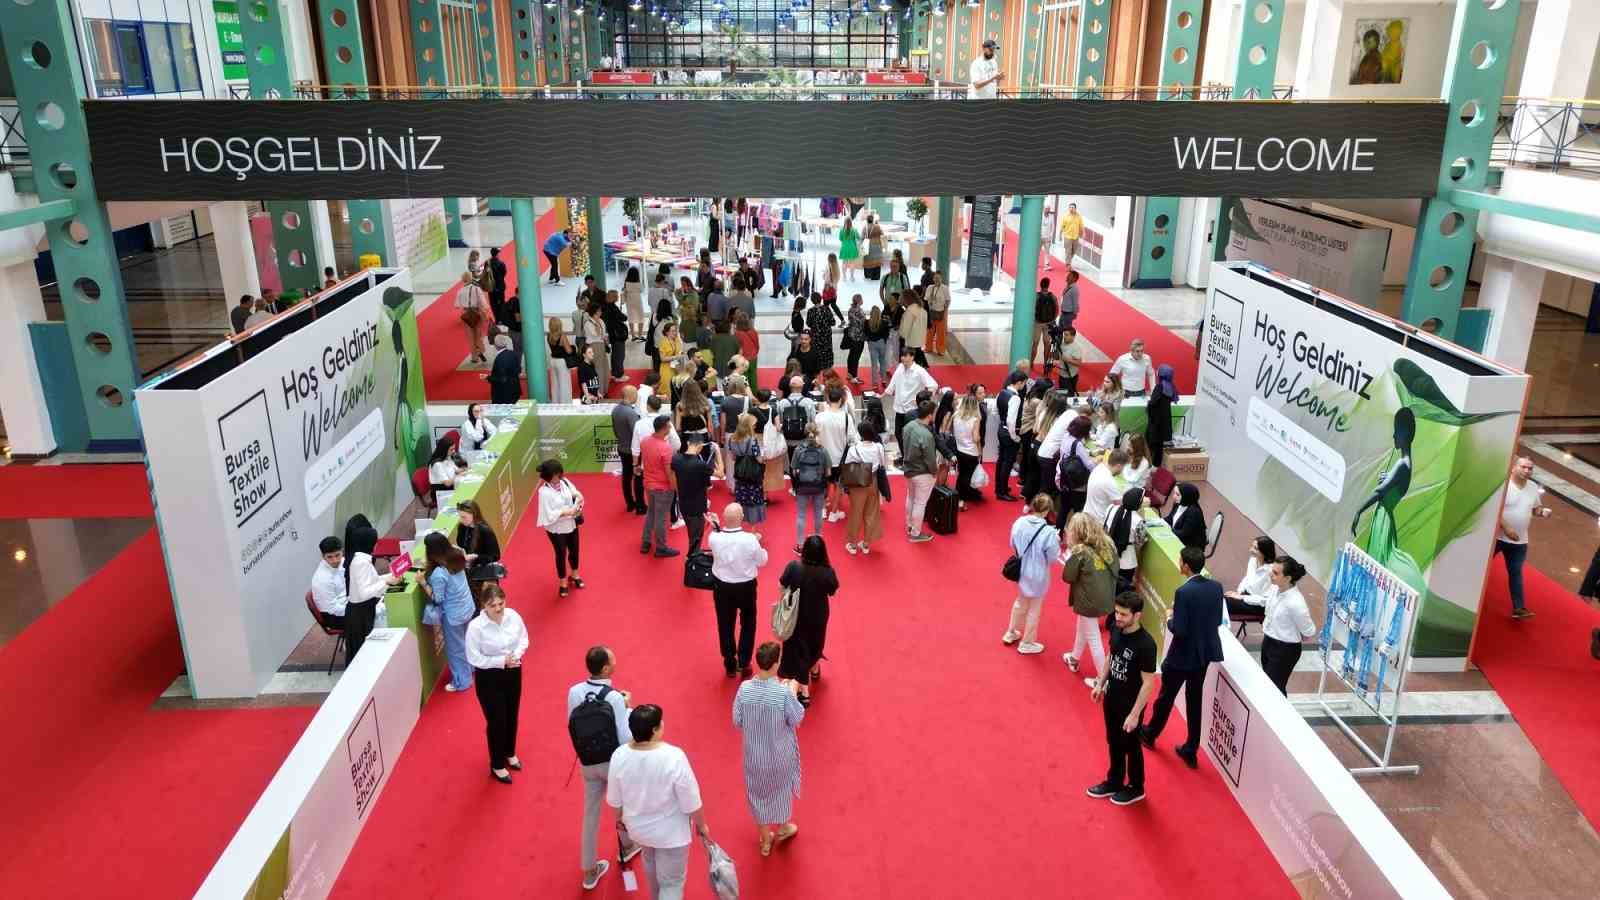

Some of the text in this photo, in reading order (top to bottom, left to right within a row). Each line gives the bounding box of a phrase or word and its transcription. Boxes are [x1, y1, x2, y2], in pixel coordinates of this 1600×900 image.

[160, 128, 444, 181] HOŞGELDİNİZ
[1173, 137, 1378, 171] WELCOME
[1209, 328, 1234, 354] Textile
[1210, 314, 1232, 337] Bursa
[281, 321, 380, 410] Hoş Geldiniz
[1207, 343, 1228, 367] Show
[1254, 309, 1286, 359] Hoş
[1292, 331, 1374, 400] Geldiniz
[1256, 354, 1353, 432] Welcome
[303, 372, 375, 462] Welcome
[224, 439, 261, 476] Bursa
[229, 455, 271, 497] Textile
[233, 480, 267, 518] Show
[1212, 711, 1237, 758] Textile
[1213, 697, 1235, 736] Bursa
[351, 740, 372, 780] Bursa
[1208, 727, 1231, 766] Show
[354, 750, 377, 794] Textile
[356, 774, 376, 811] Show
